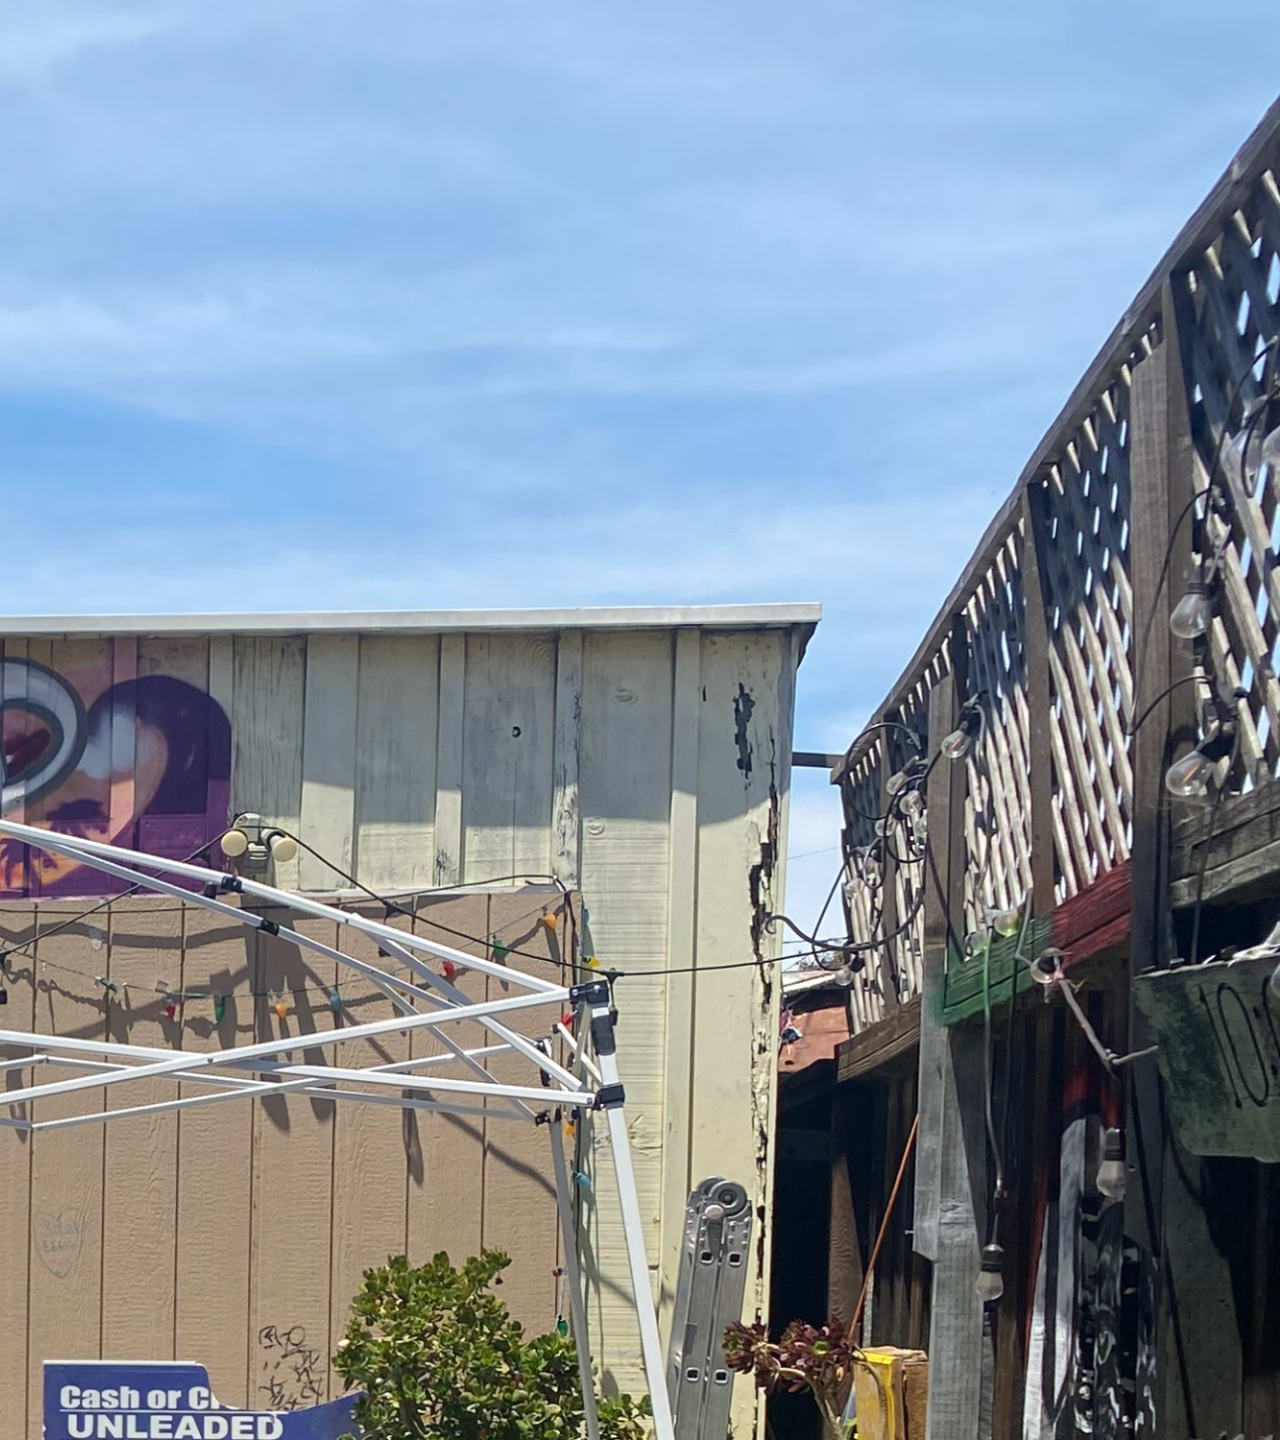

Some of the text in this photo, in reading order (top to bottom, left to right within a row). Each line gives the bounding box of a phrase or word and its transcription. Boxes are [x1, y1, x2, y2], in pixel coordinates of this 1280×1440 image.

[60, 1385, 130, 1409] Cash
[147, 1389, 182, 1409] or
[67, 1414, 284, 1440] UNLEADED
